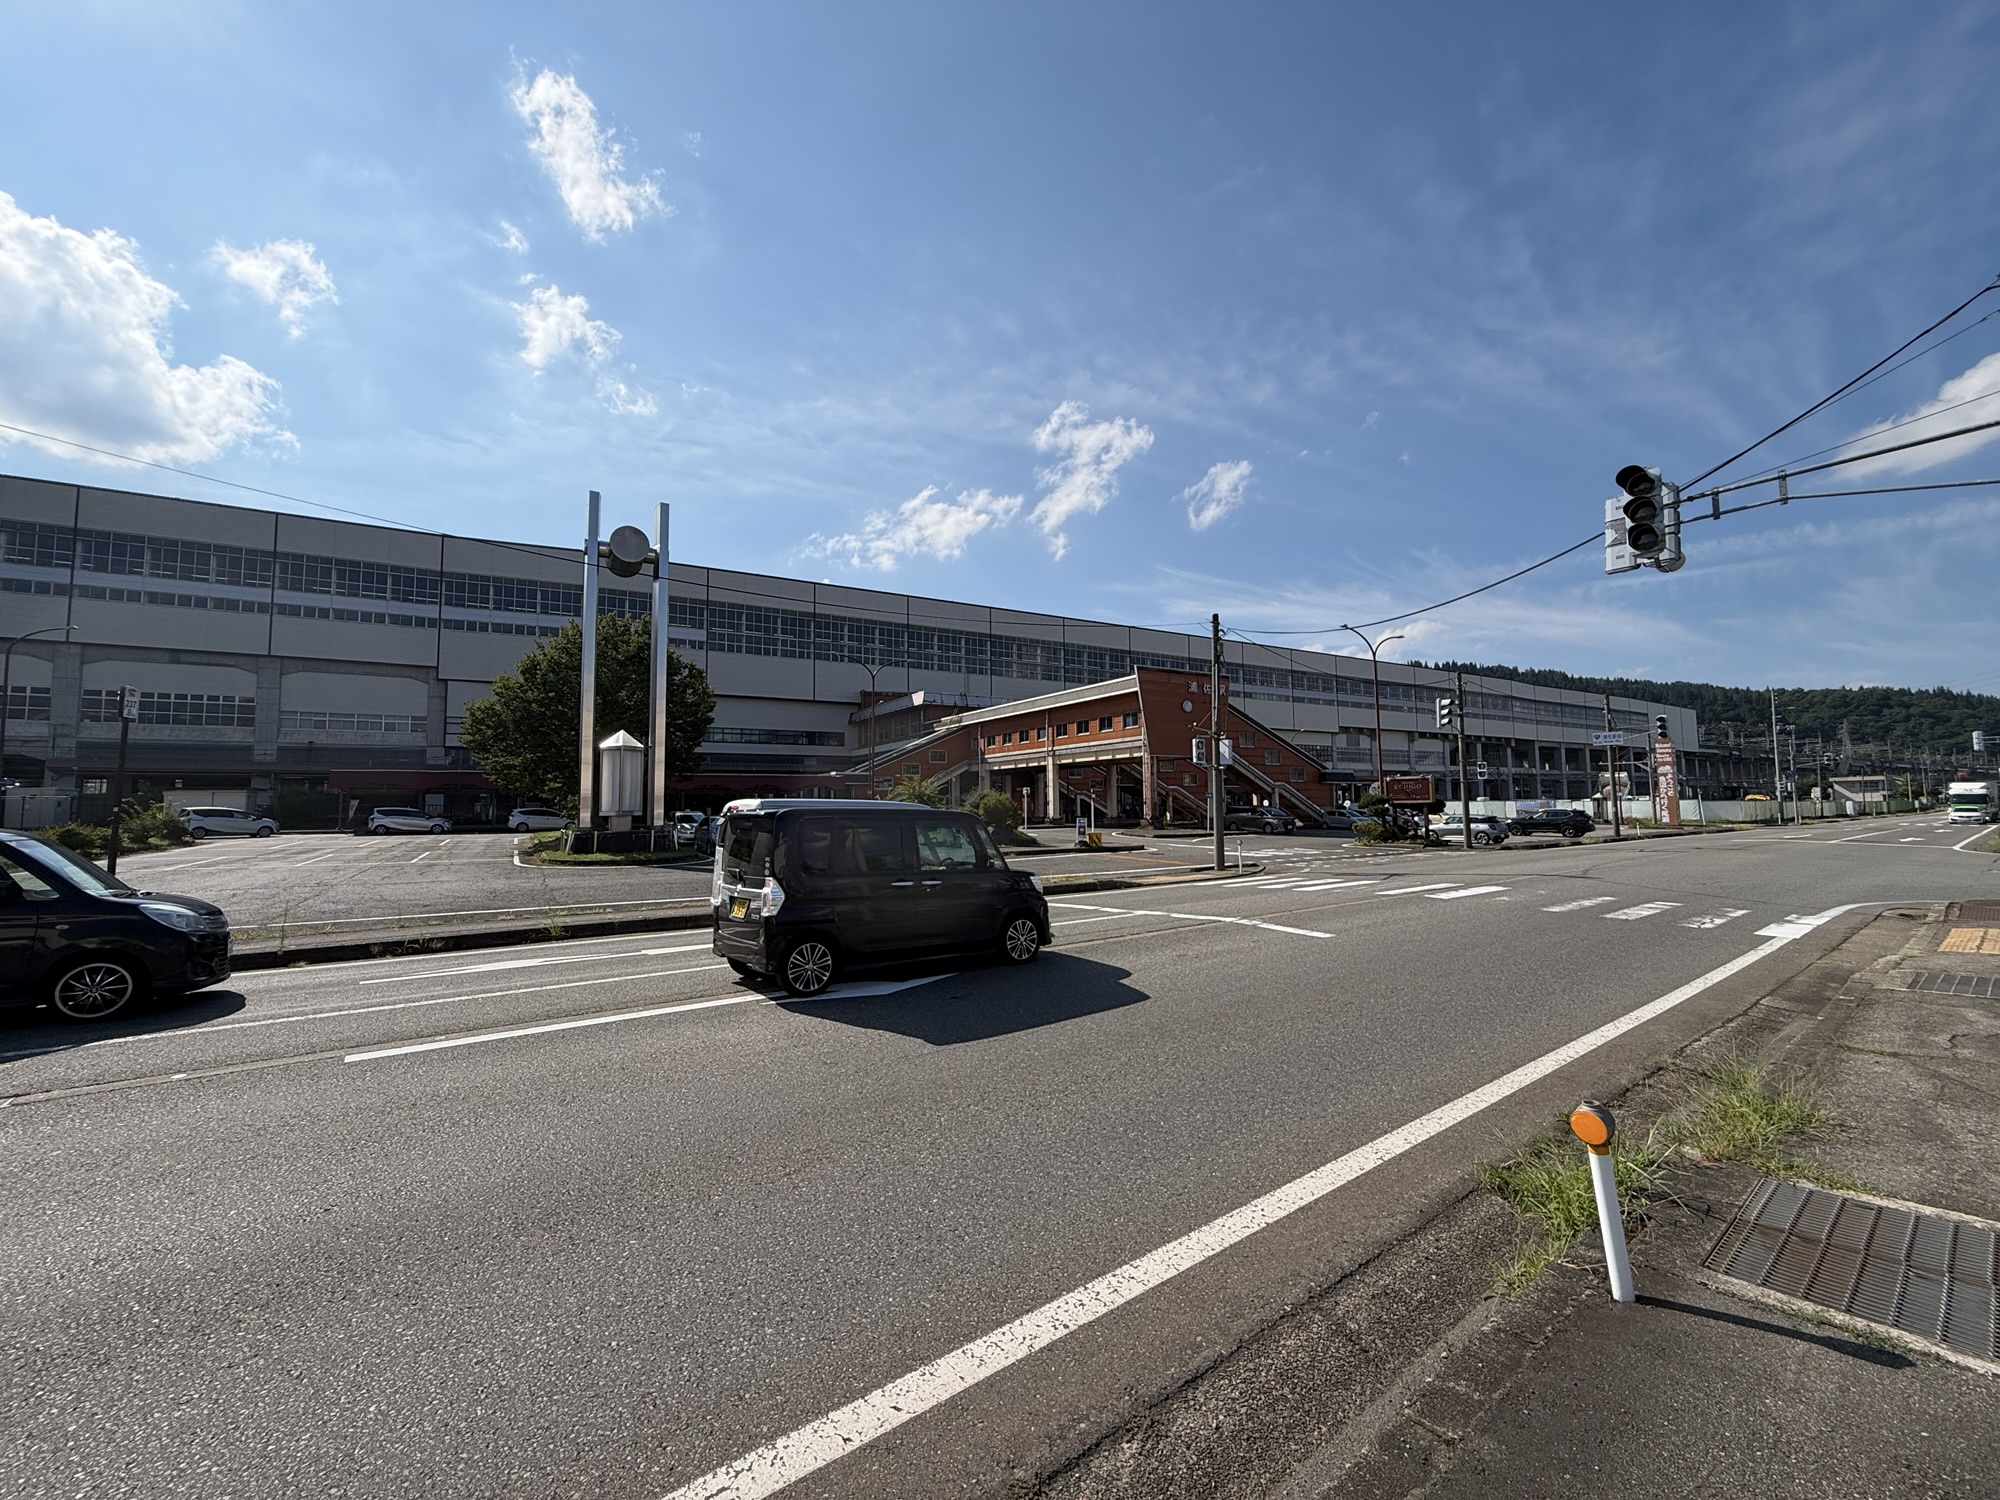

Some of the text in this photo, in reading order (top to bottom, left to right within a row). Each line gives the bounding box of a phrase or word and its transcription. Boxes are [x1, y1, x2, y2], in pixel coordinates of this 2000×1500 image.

[126, 700, 137, 708] 237
[1666, 773, 1675, 796] ようこそ
